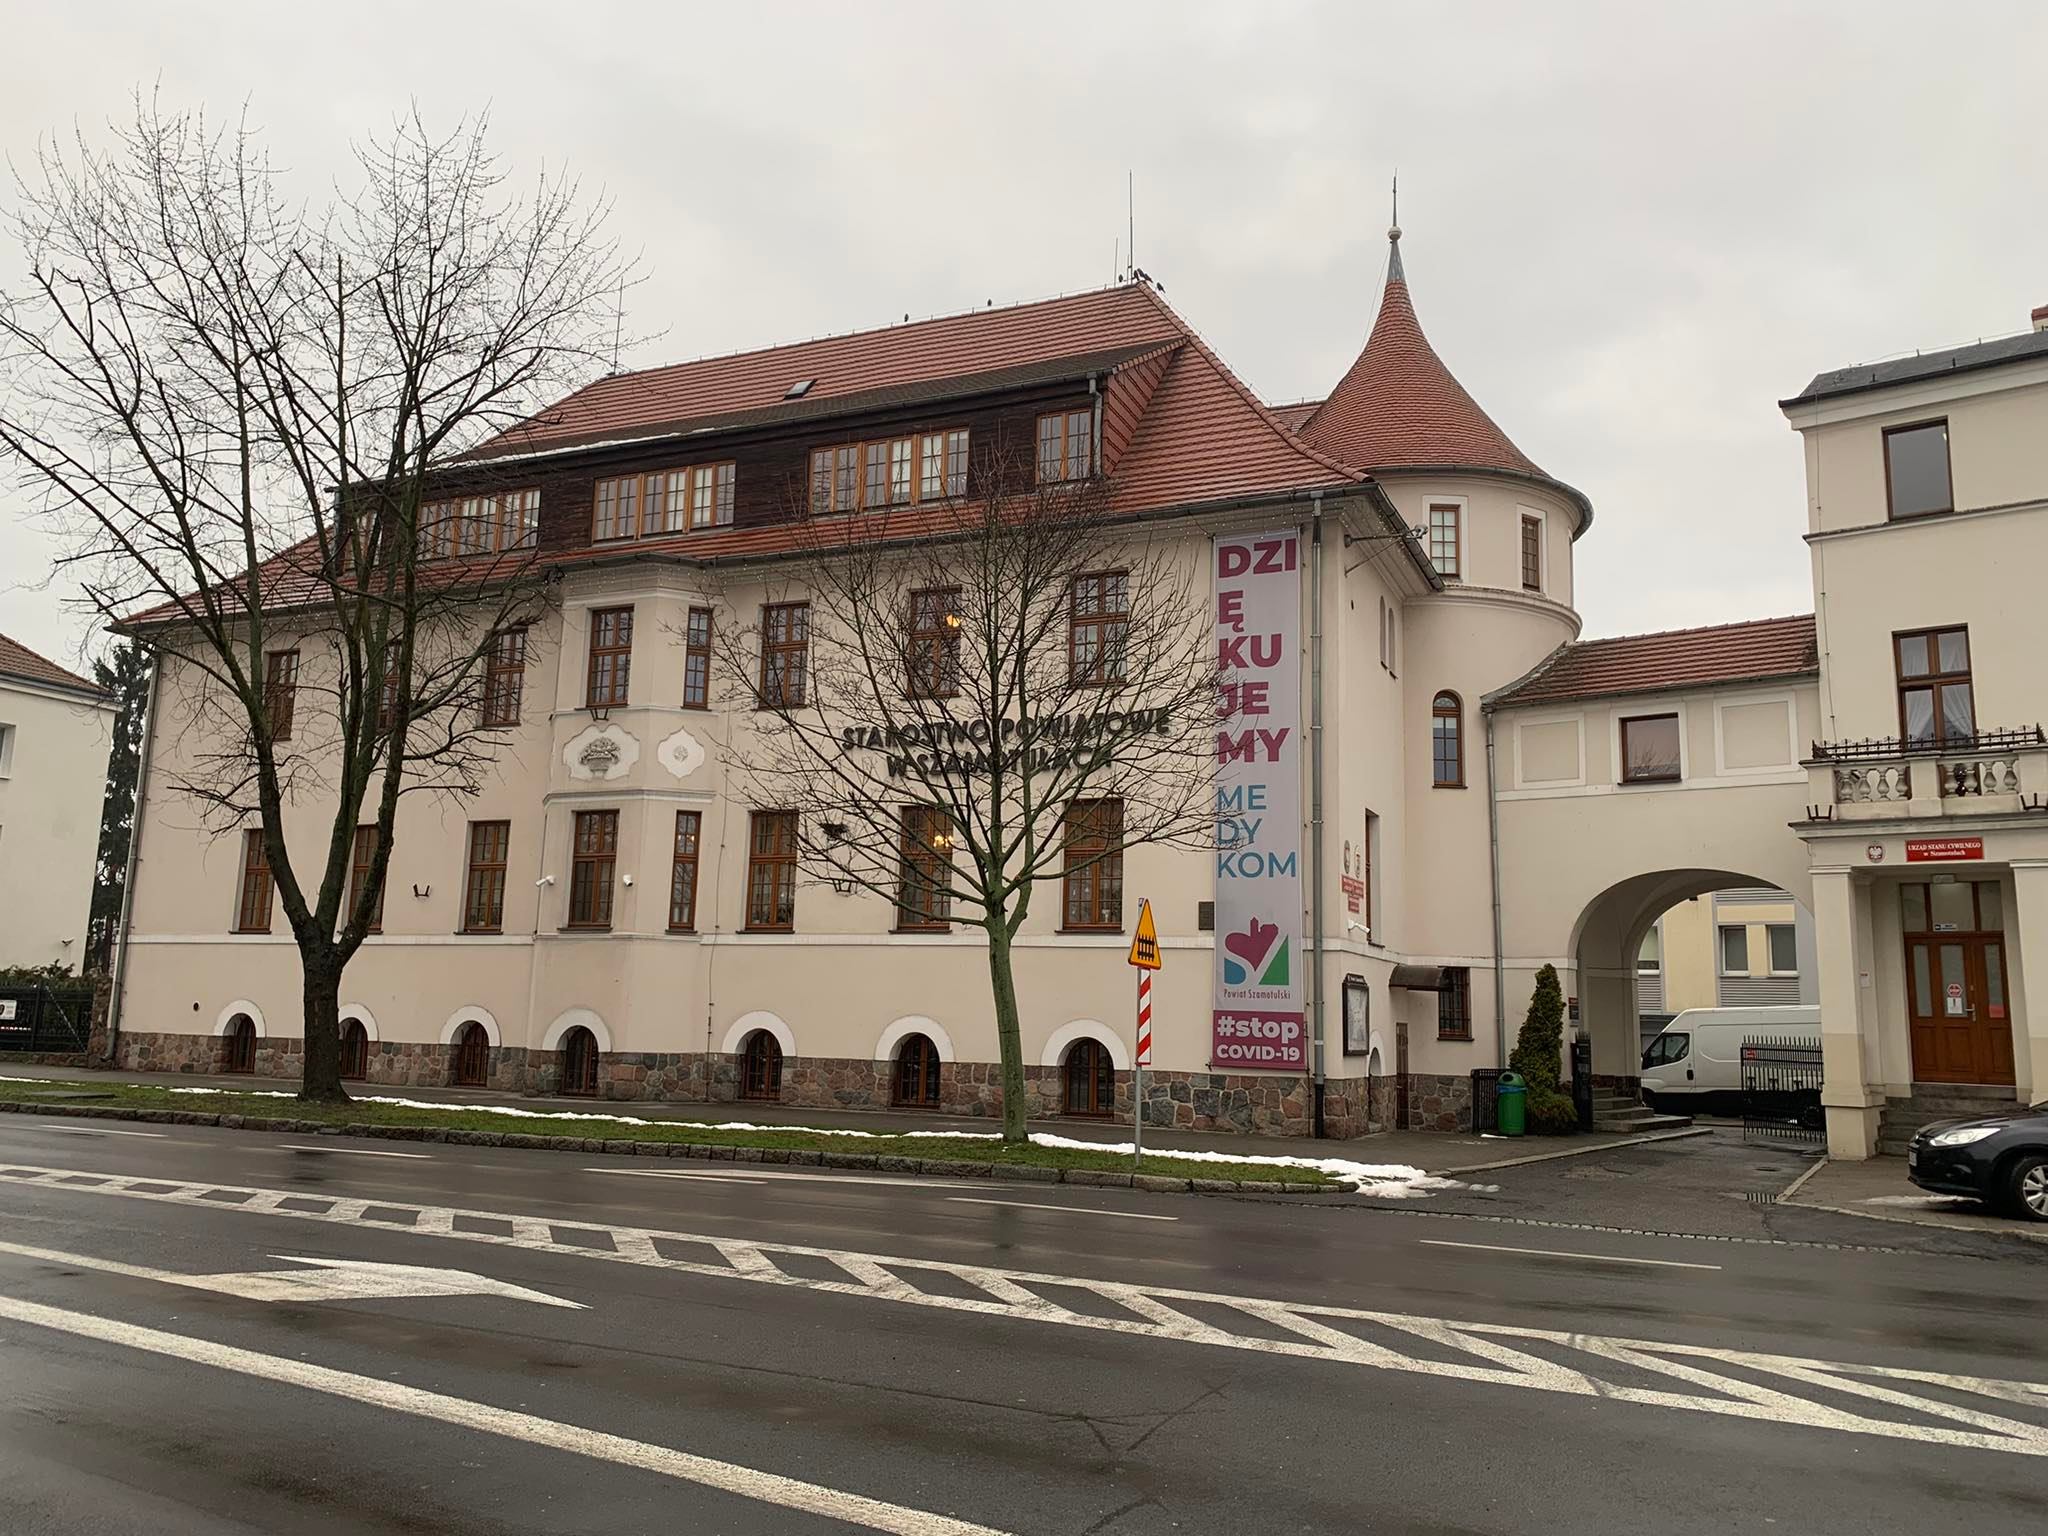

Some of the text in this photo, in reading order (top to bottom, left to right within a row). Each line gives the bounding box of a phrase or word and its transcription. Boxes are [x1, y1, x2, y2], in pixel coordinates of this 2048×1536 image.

[1218, 539, 1297, 579] DZI
[1218, 590, 1245, 632] Ę
[1218, 634, 1282, 670] KU
[1217, 682, 1269, 717] JE
[842, 719, 990, 750] STAROSTWO
[1217, 728, 1291, 764] MY
[1217, 785, 1267, 811] ME
[1217, 819, 1262, 844] DY
[1217, 852, 1296, 879] KOM
[1223, 988, 1291, 1000] Powiat Szamotulski
[1217, 1016, 1300, 1043] #stop
[1216, 1044, 1300, 1061] COVID-19
